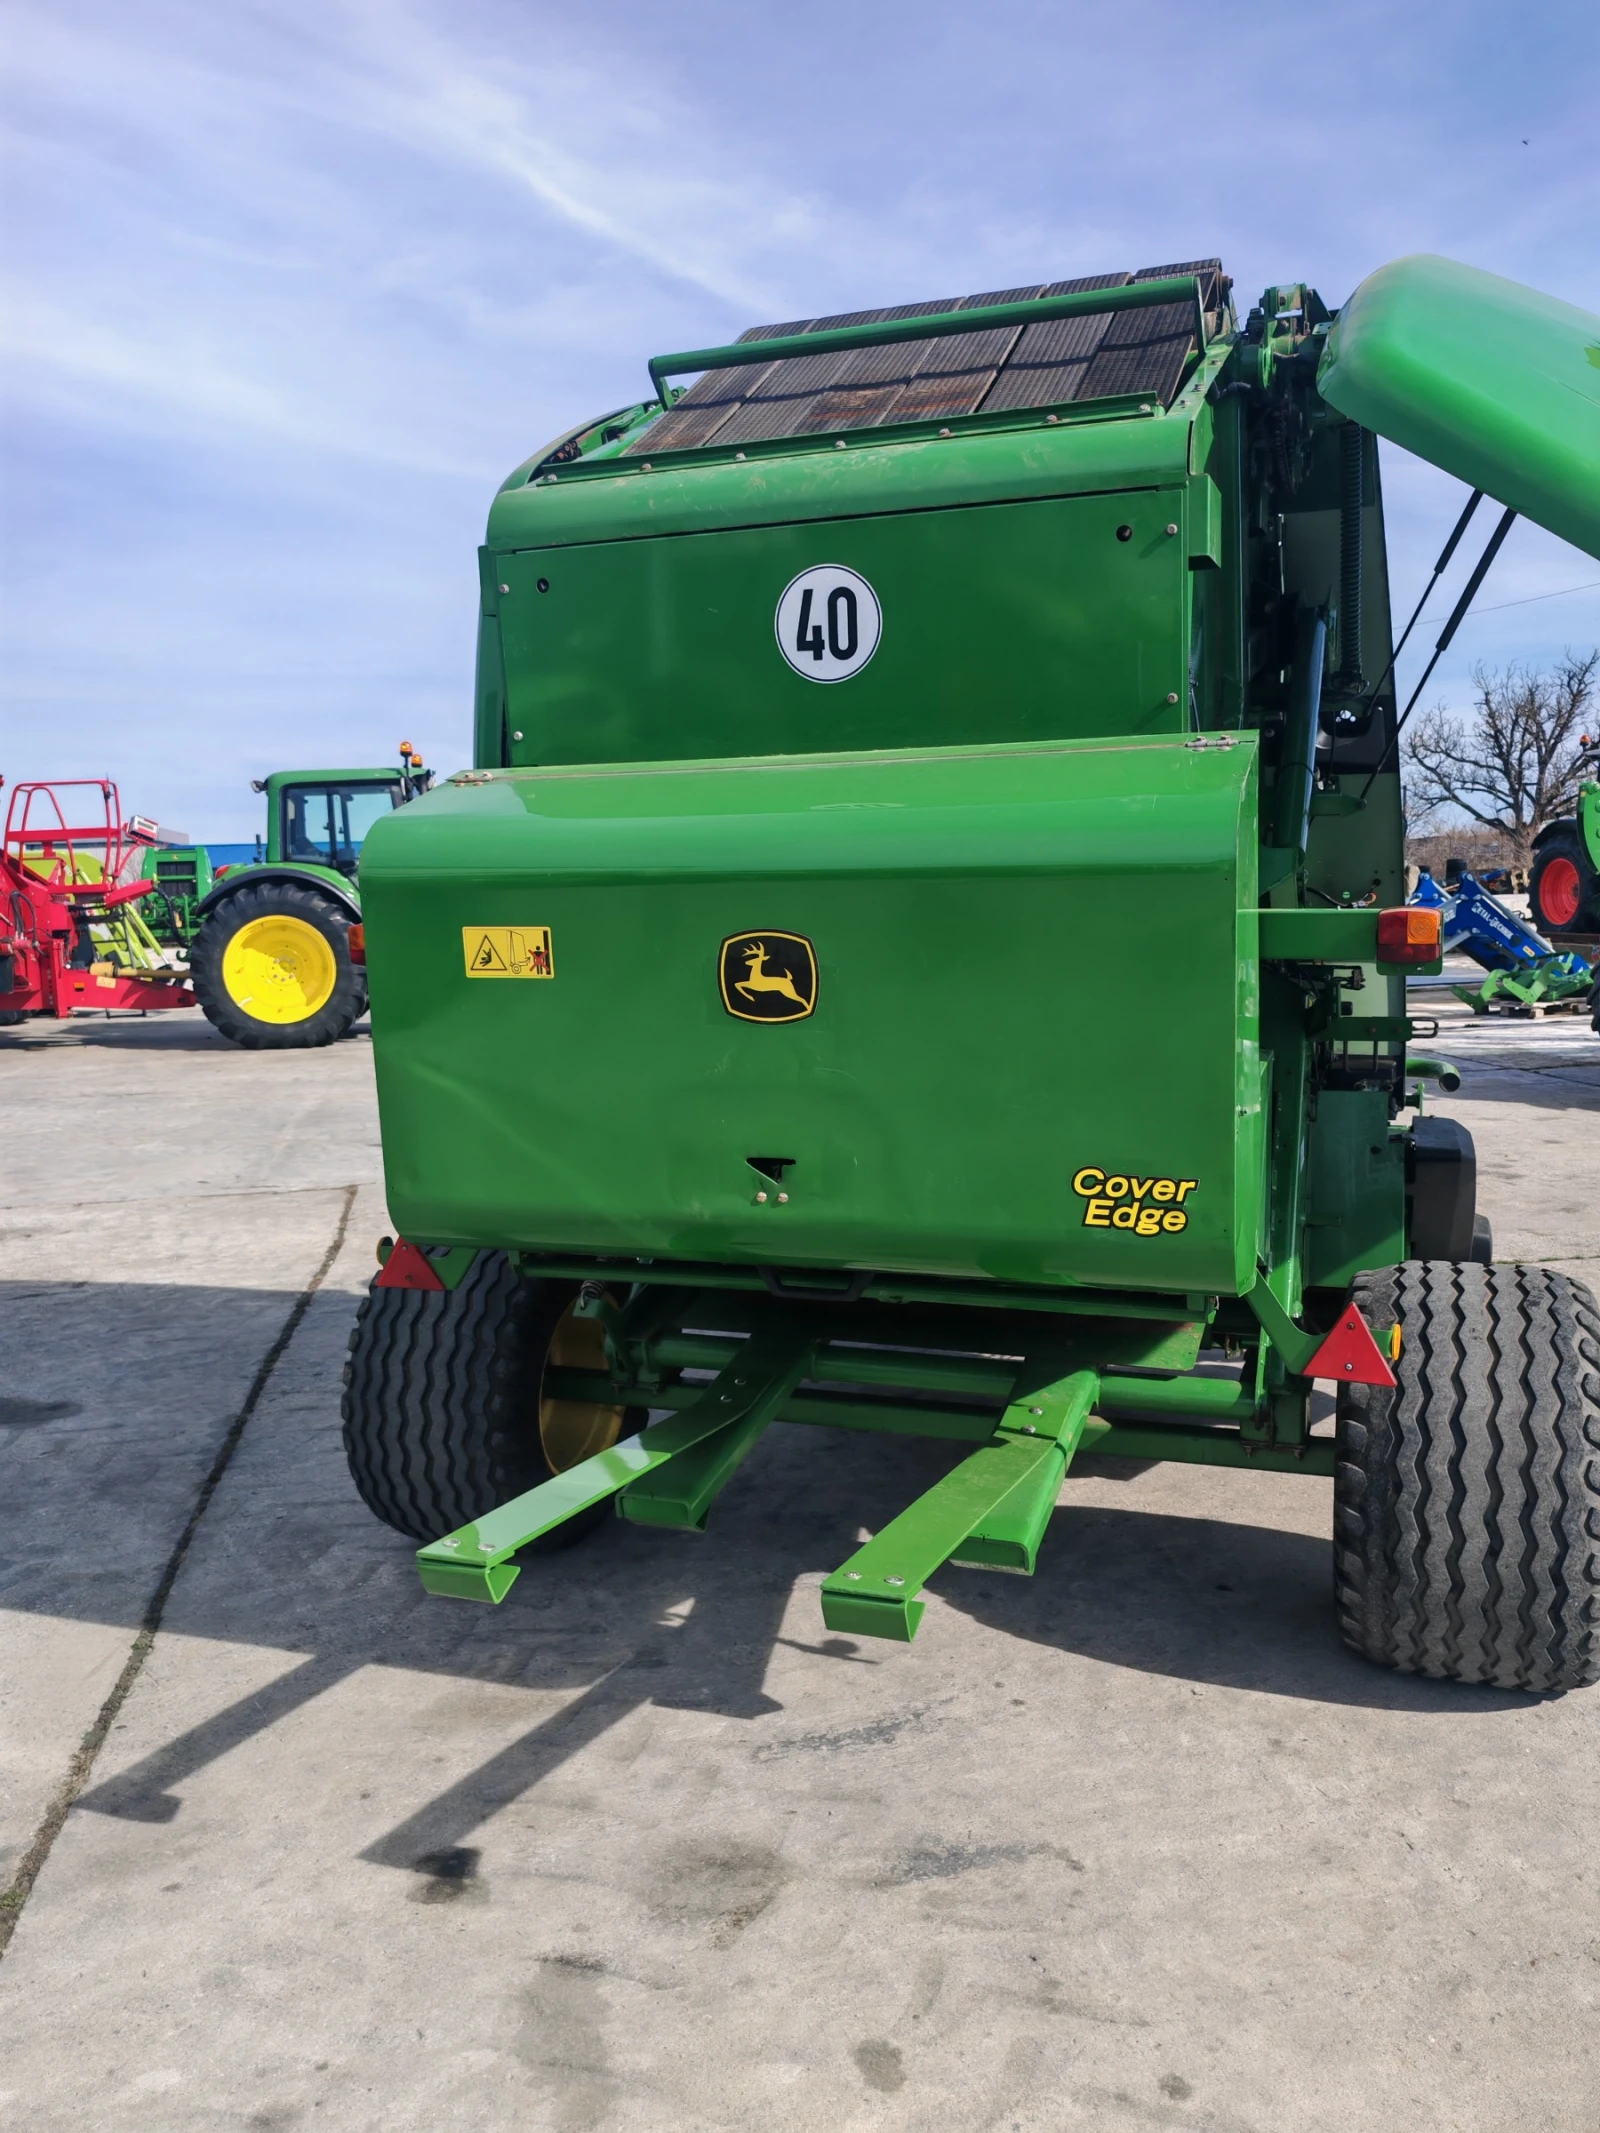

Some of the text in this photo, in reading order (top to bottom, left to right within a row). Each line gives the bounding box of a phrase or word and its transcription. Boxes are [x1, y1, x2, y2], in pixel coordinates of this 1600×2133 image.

[796, 586, 858, 661] 40
[1073, 1167, 1197, 1202] Cover
[1084, 1198, 1187, 1235] Edge
